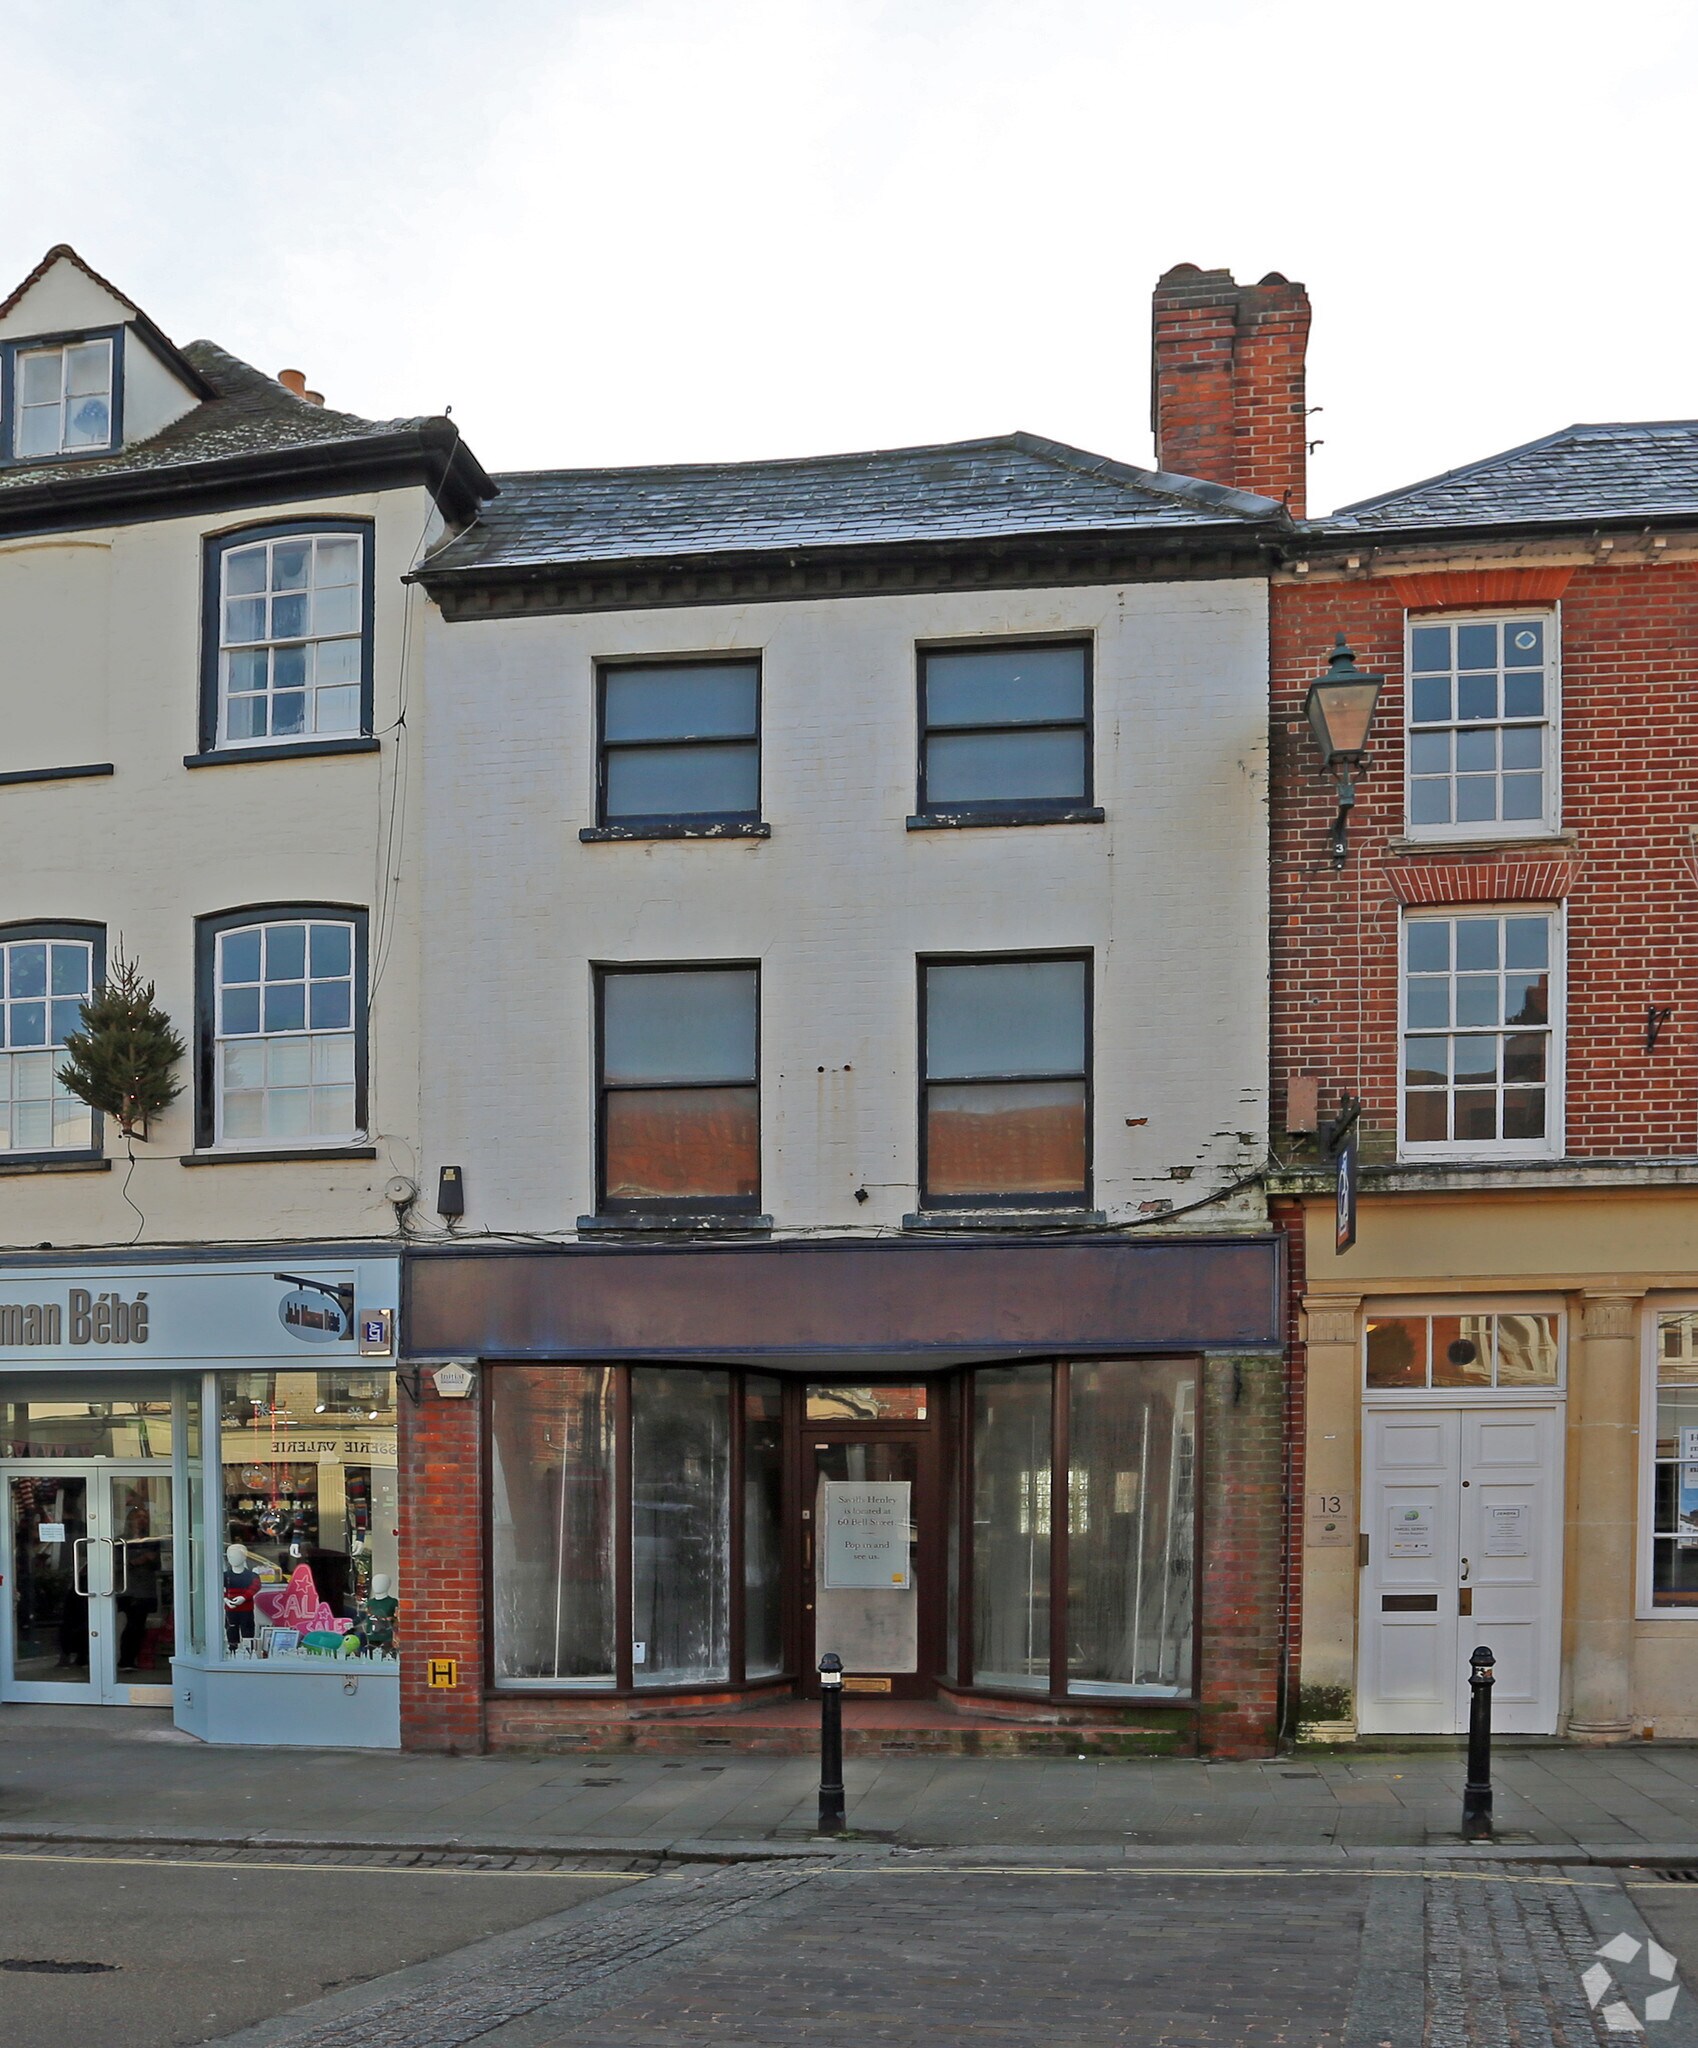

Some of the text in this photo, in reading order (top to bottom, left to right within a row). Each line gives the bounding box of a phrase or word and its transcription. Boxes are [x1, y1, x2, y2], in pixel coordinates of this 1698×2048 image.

[1335, 843, 1345, 853] 3
[69, 1288, 149, 1345] Bébé
[368, 1322, 381, 1342] ADT
[867, 1496, 896, 1504] Henley
[1320, 1496, 1341, 1513] 13
[853, 1507, 881, 1515] located
[837, 1518, 849, 1526] 60
[851, 1518, 868, 1526] Bell
[845, 1541, 861, 1550] Pop
[432, 1661, 453, 1685] H
